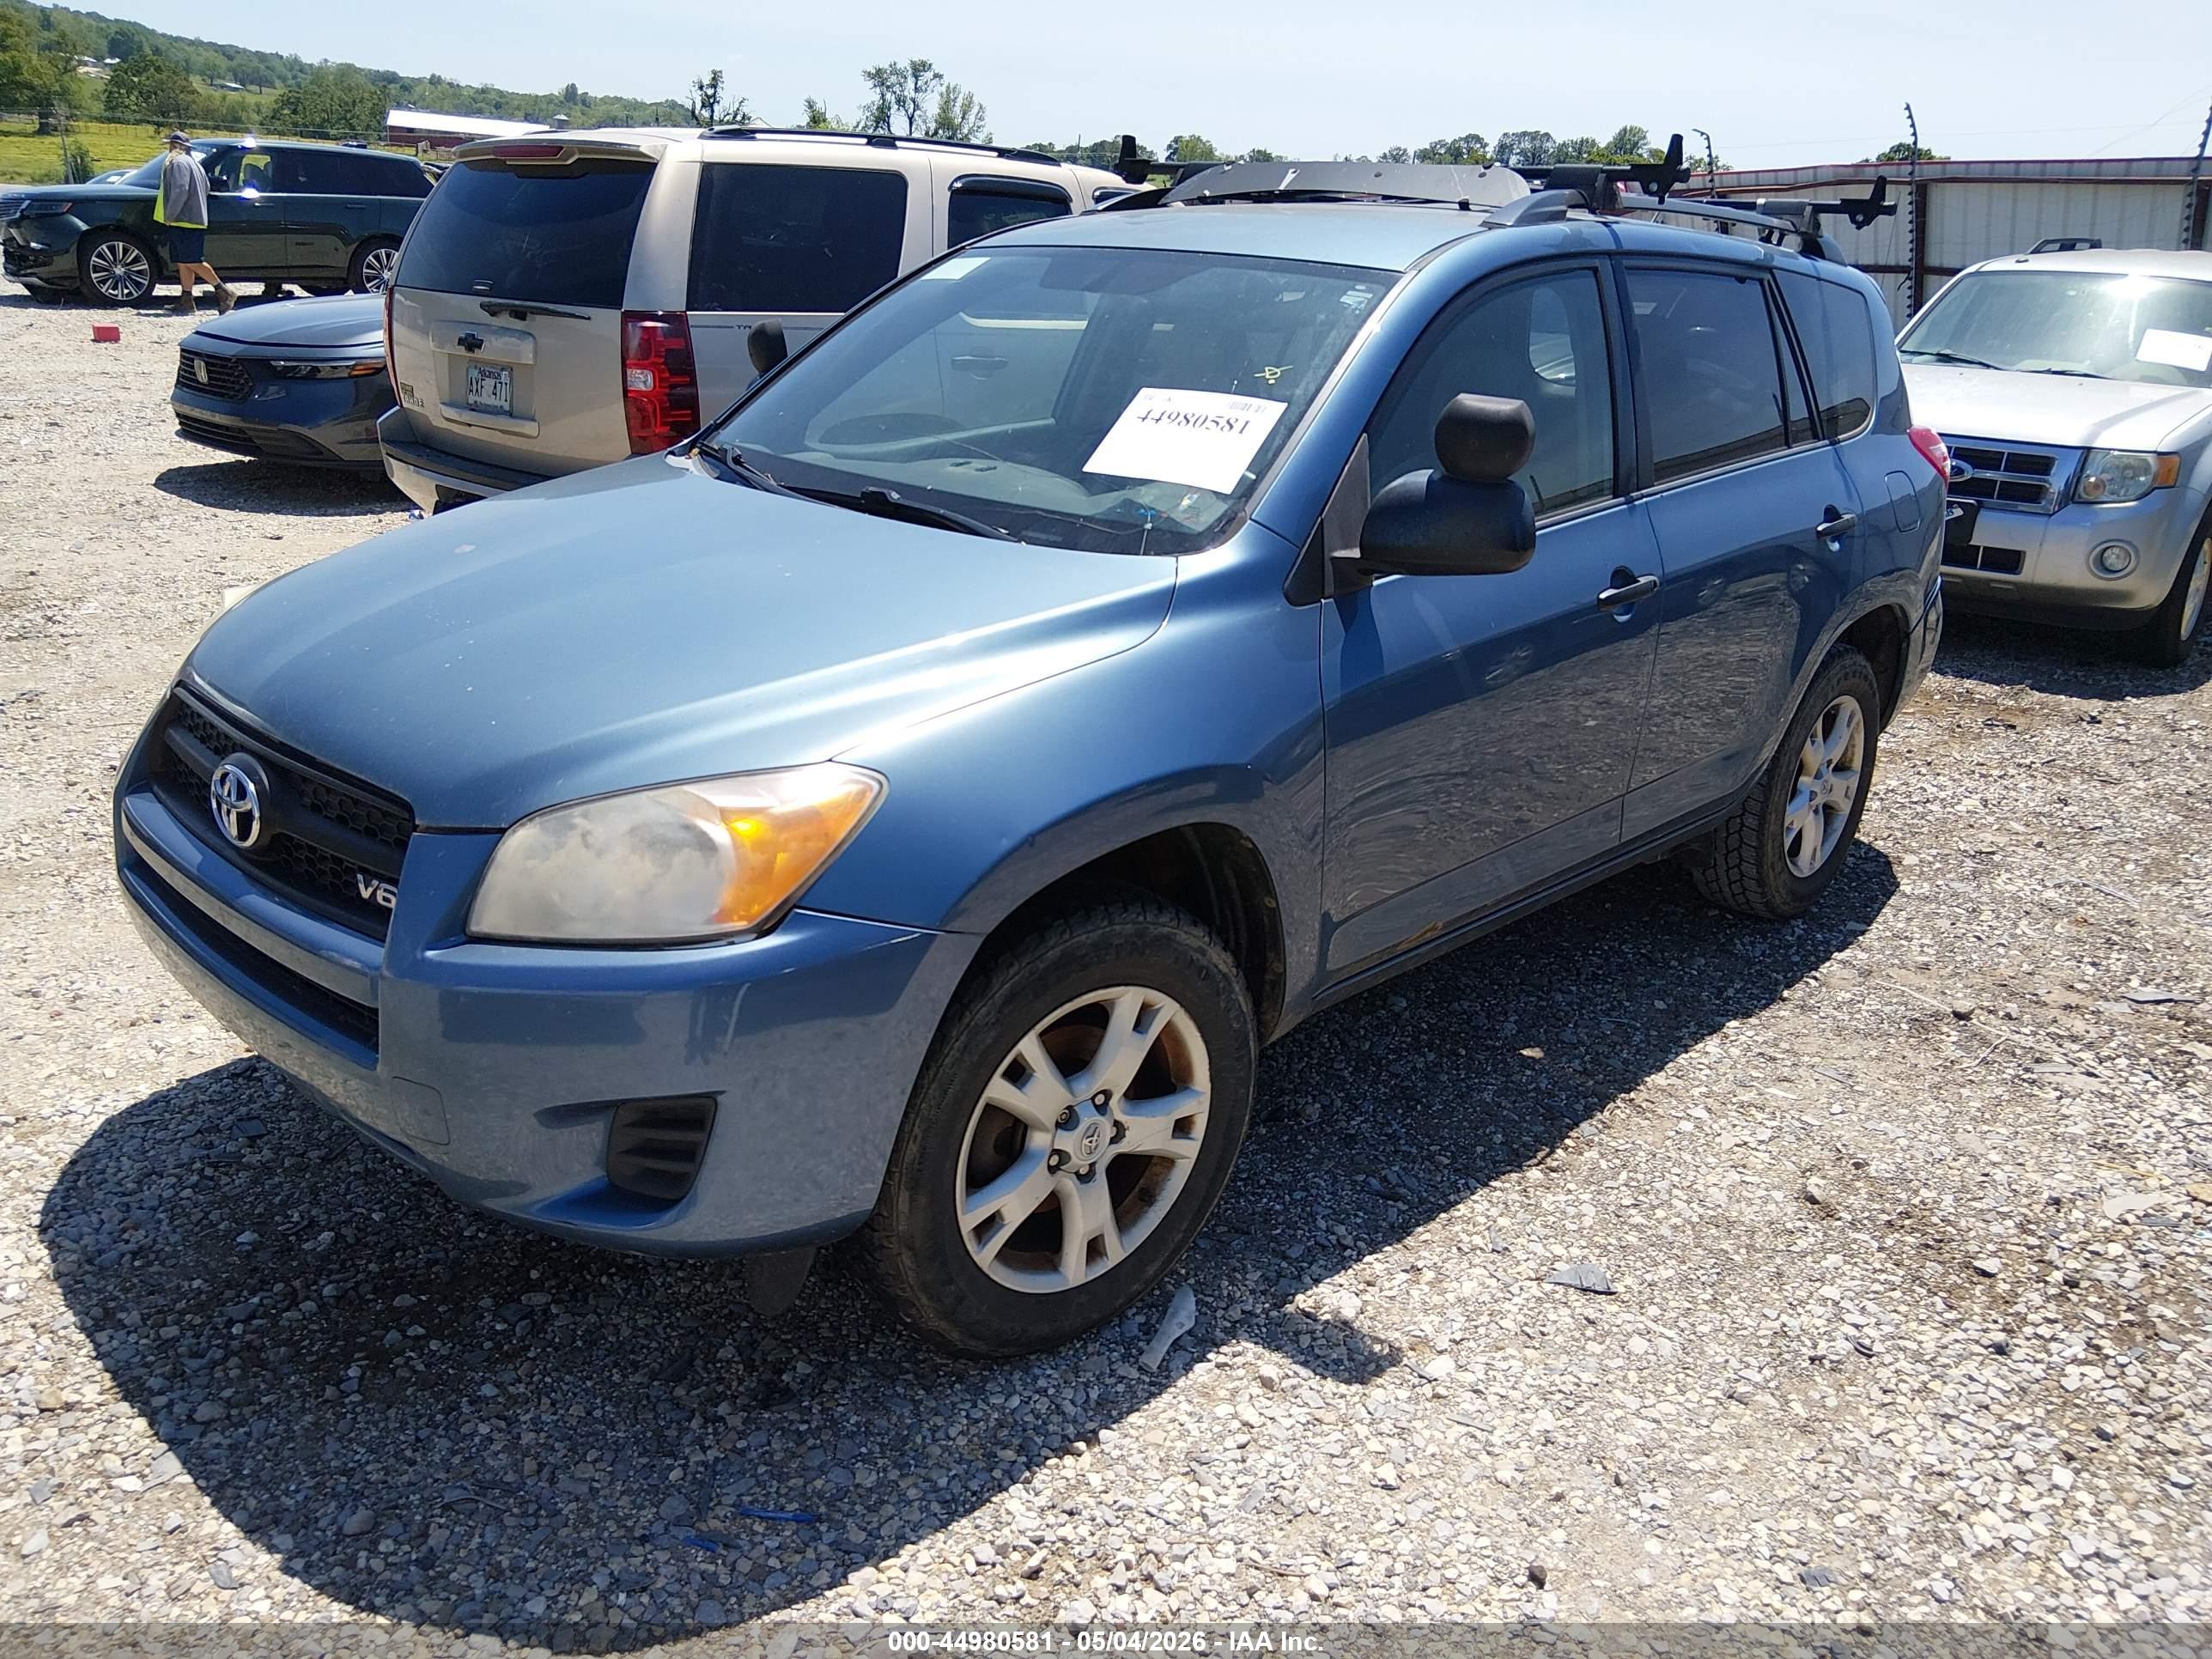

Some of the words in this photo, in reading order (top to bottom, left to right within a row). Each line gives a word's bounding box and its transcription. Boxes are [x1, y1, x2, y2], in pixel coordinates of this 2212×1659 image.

[477, 367, 502, 380] Arkansas
[468, 376, 486, 398] AXF
[1137, 409, 1251, 434] 44980581
[357, 873, 398, 908] V6
